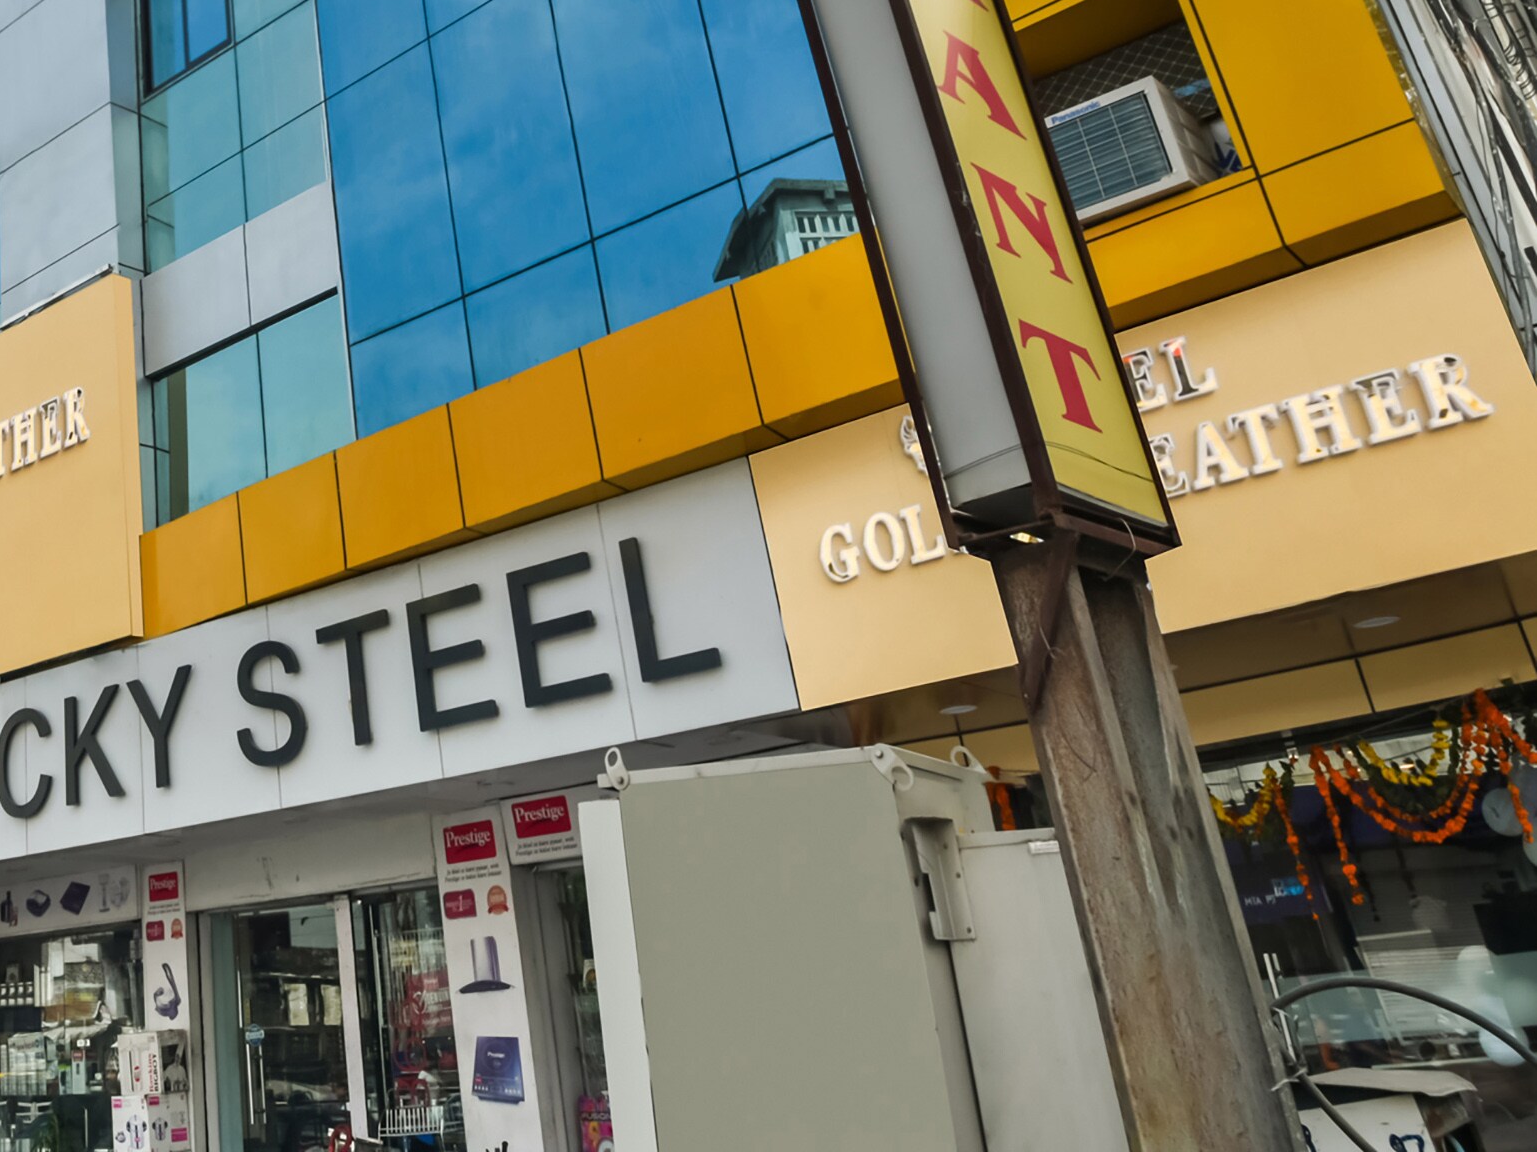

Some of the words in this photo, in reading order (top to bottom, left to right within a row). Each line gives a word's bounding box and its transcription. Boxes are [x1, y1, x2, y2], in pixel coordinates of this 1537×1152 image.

[1051, 100, 1101, 124] Panasonic
[820, 504, 947, 583] GOL
[1148, 353, 1494, 499] EATHER
[236, 536, 723, 768] STEEL
[514, 804, 564, 823] Prestige
[445, 828, 490, 847] Prestige
[150, 877, 176, 890] Prestige
